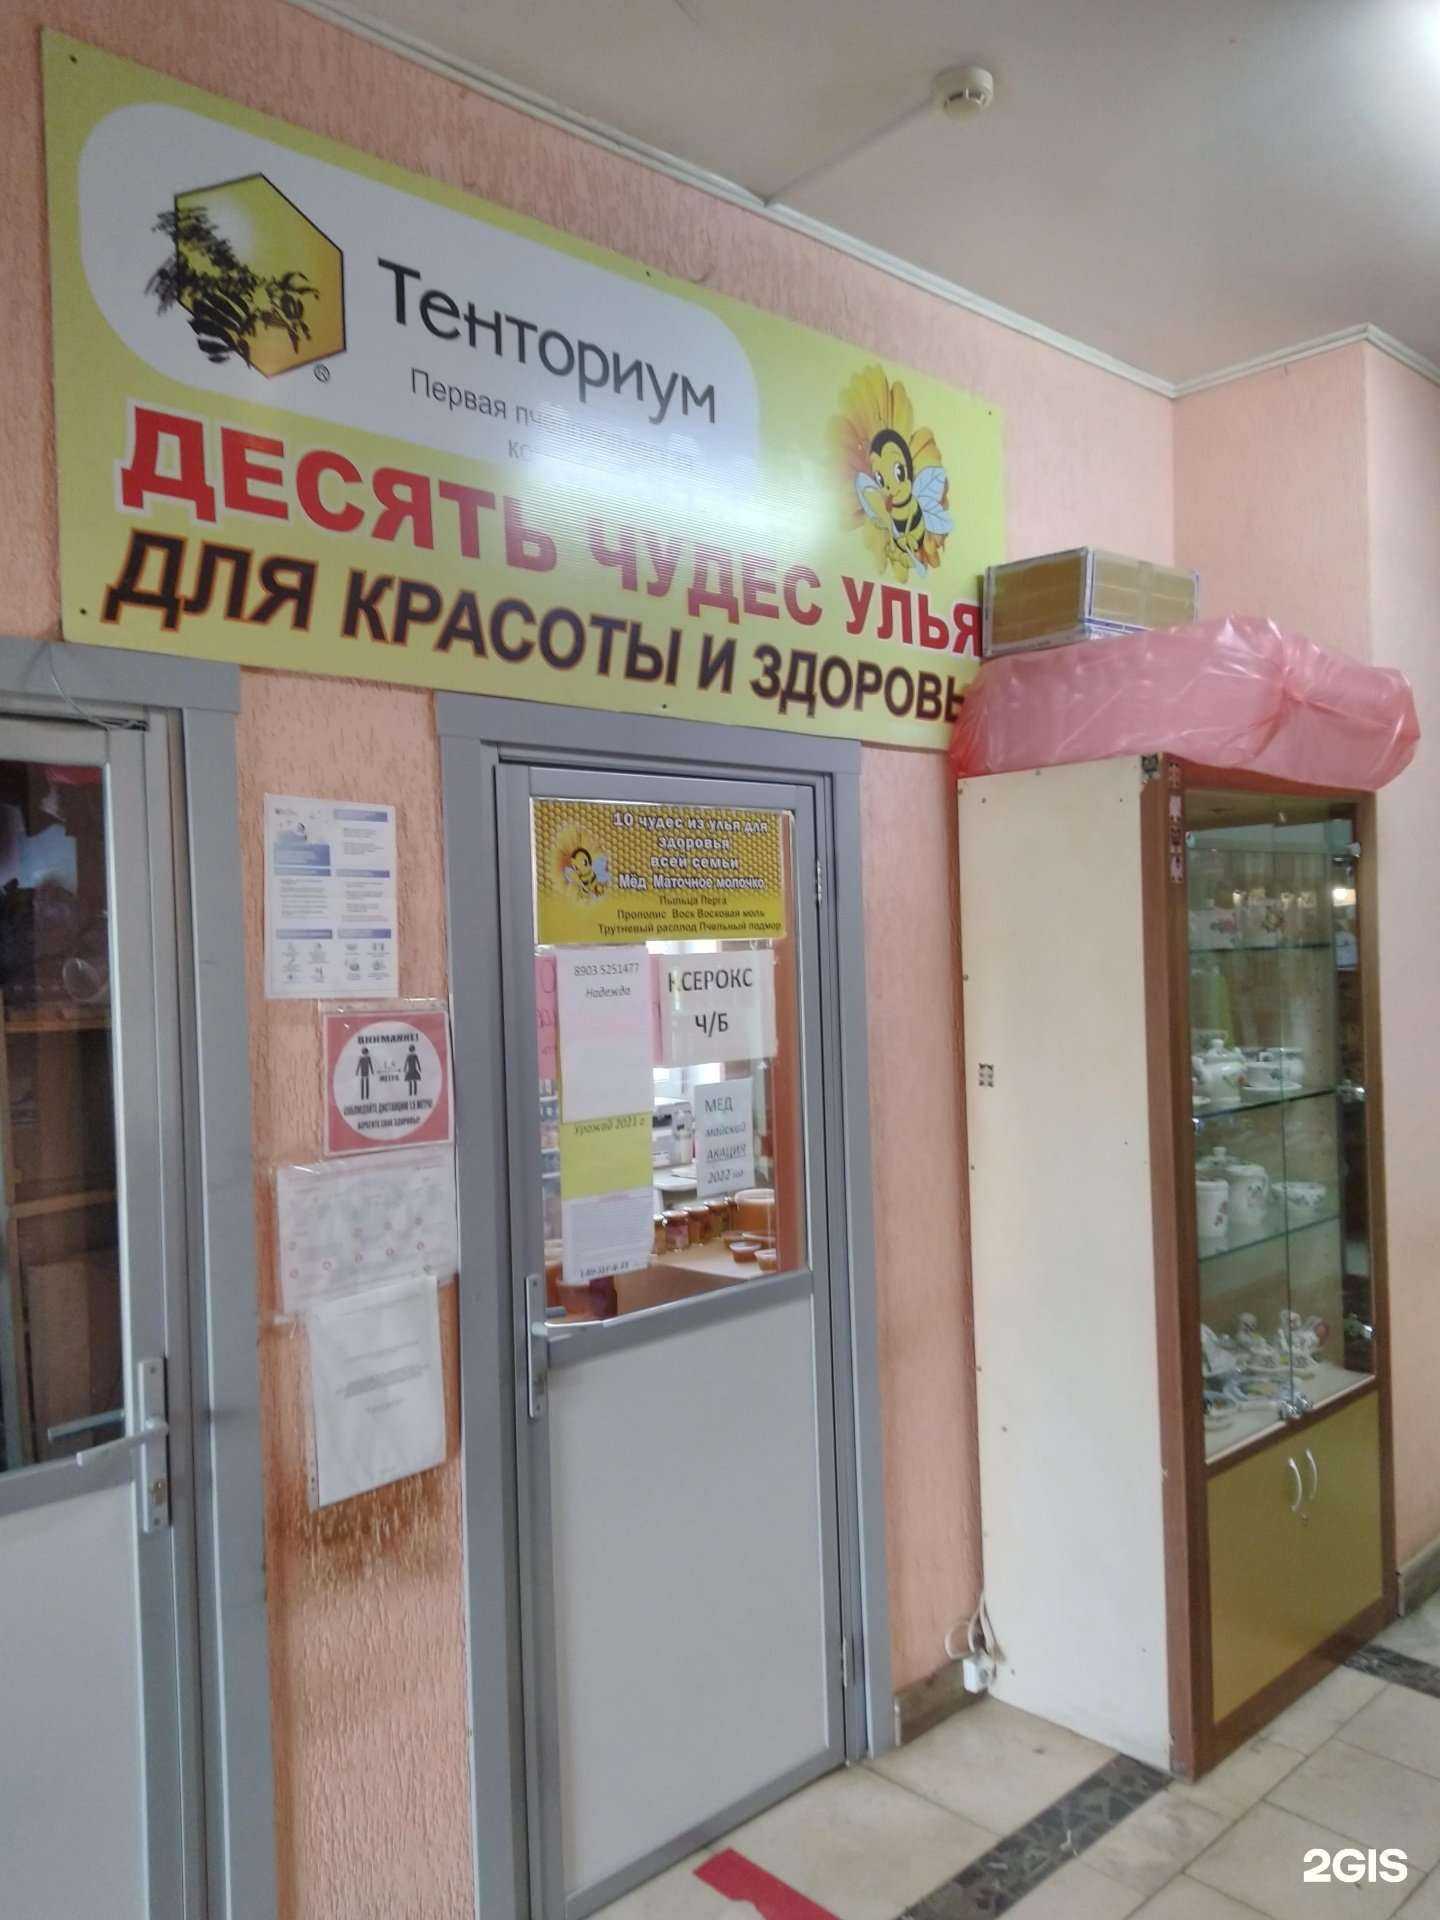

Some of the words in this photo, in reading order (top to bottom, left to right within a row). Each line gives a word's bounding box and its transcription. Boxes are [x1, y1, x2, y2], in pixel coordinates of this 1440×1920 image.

[378, 256, 718, 426] Тенториум
[410, 367, 507, 420] Первая
[120, 405, 560, 574] ДЕСЯТЬ
[587, 510, 824, 628] ЧУДЕС
[840, 574, 984, 658] УЛЬЯ
[104, 528, 318, 632] ДЛЯ
[342, 570, 682, 688] КРАСОТЫ
[697, 633, 737, 695] И
[613, 812, 634, 827] 10
[638, 816, 684, 832] чудес
[687, 818, 705, 830] из
[708, 818, 741, 834] улья
[744, 820, 769, 834] для
[658, 837, 731, 850] здоровья
[692, 856, 739, 870] семьи
[618, 873, 647, 889] Мёд
[653, 874, 713, 889] Маточное
[694, 1011, 729, 1038] Ч/Б
